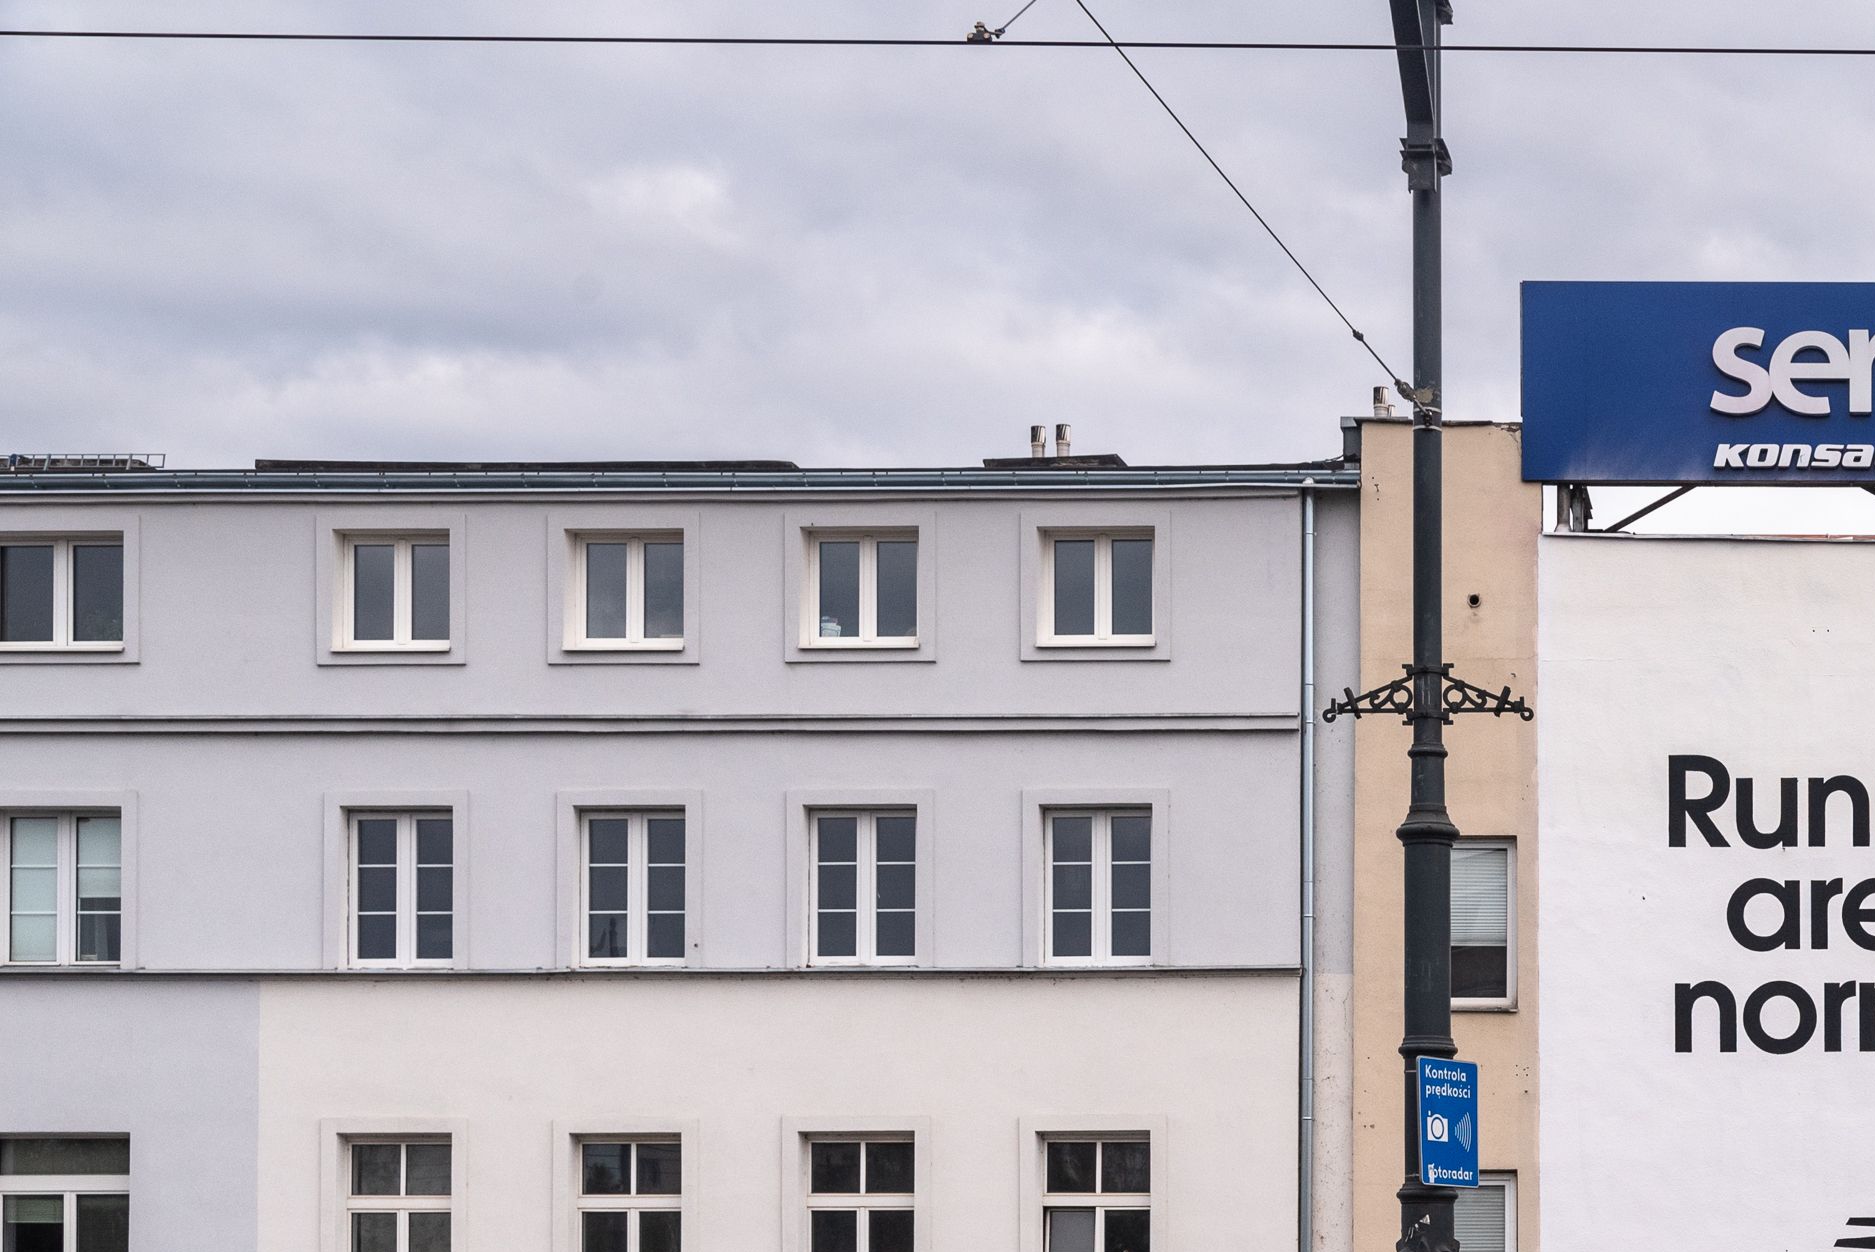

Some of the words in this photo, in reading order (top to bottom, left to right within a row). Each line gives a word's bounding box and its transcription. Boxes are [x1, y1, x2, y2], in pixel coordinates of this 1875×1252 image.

[1425, 1064, 1467, 1082] Kontrola
[1425, 1083, 1471, 1099] prędkości
[1428, 1164, 1473, 1181] otoradar
